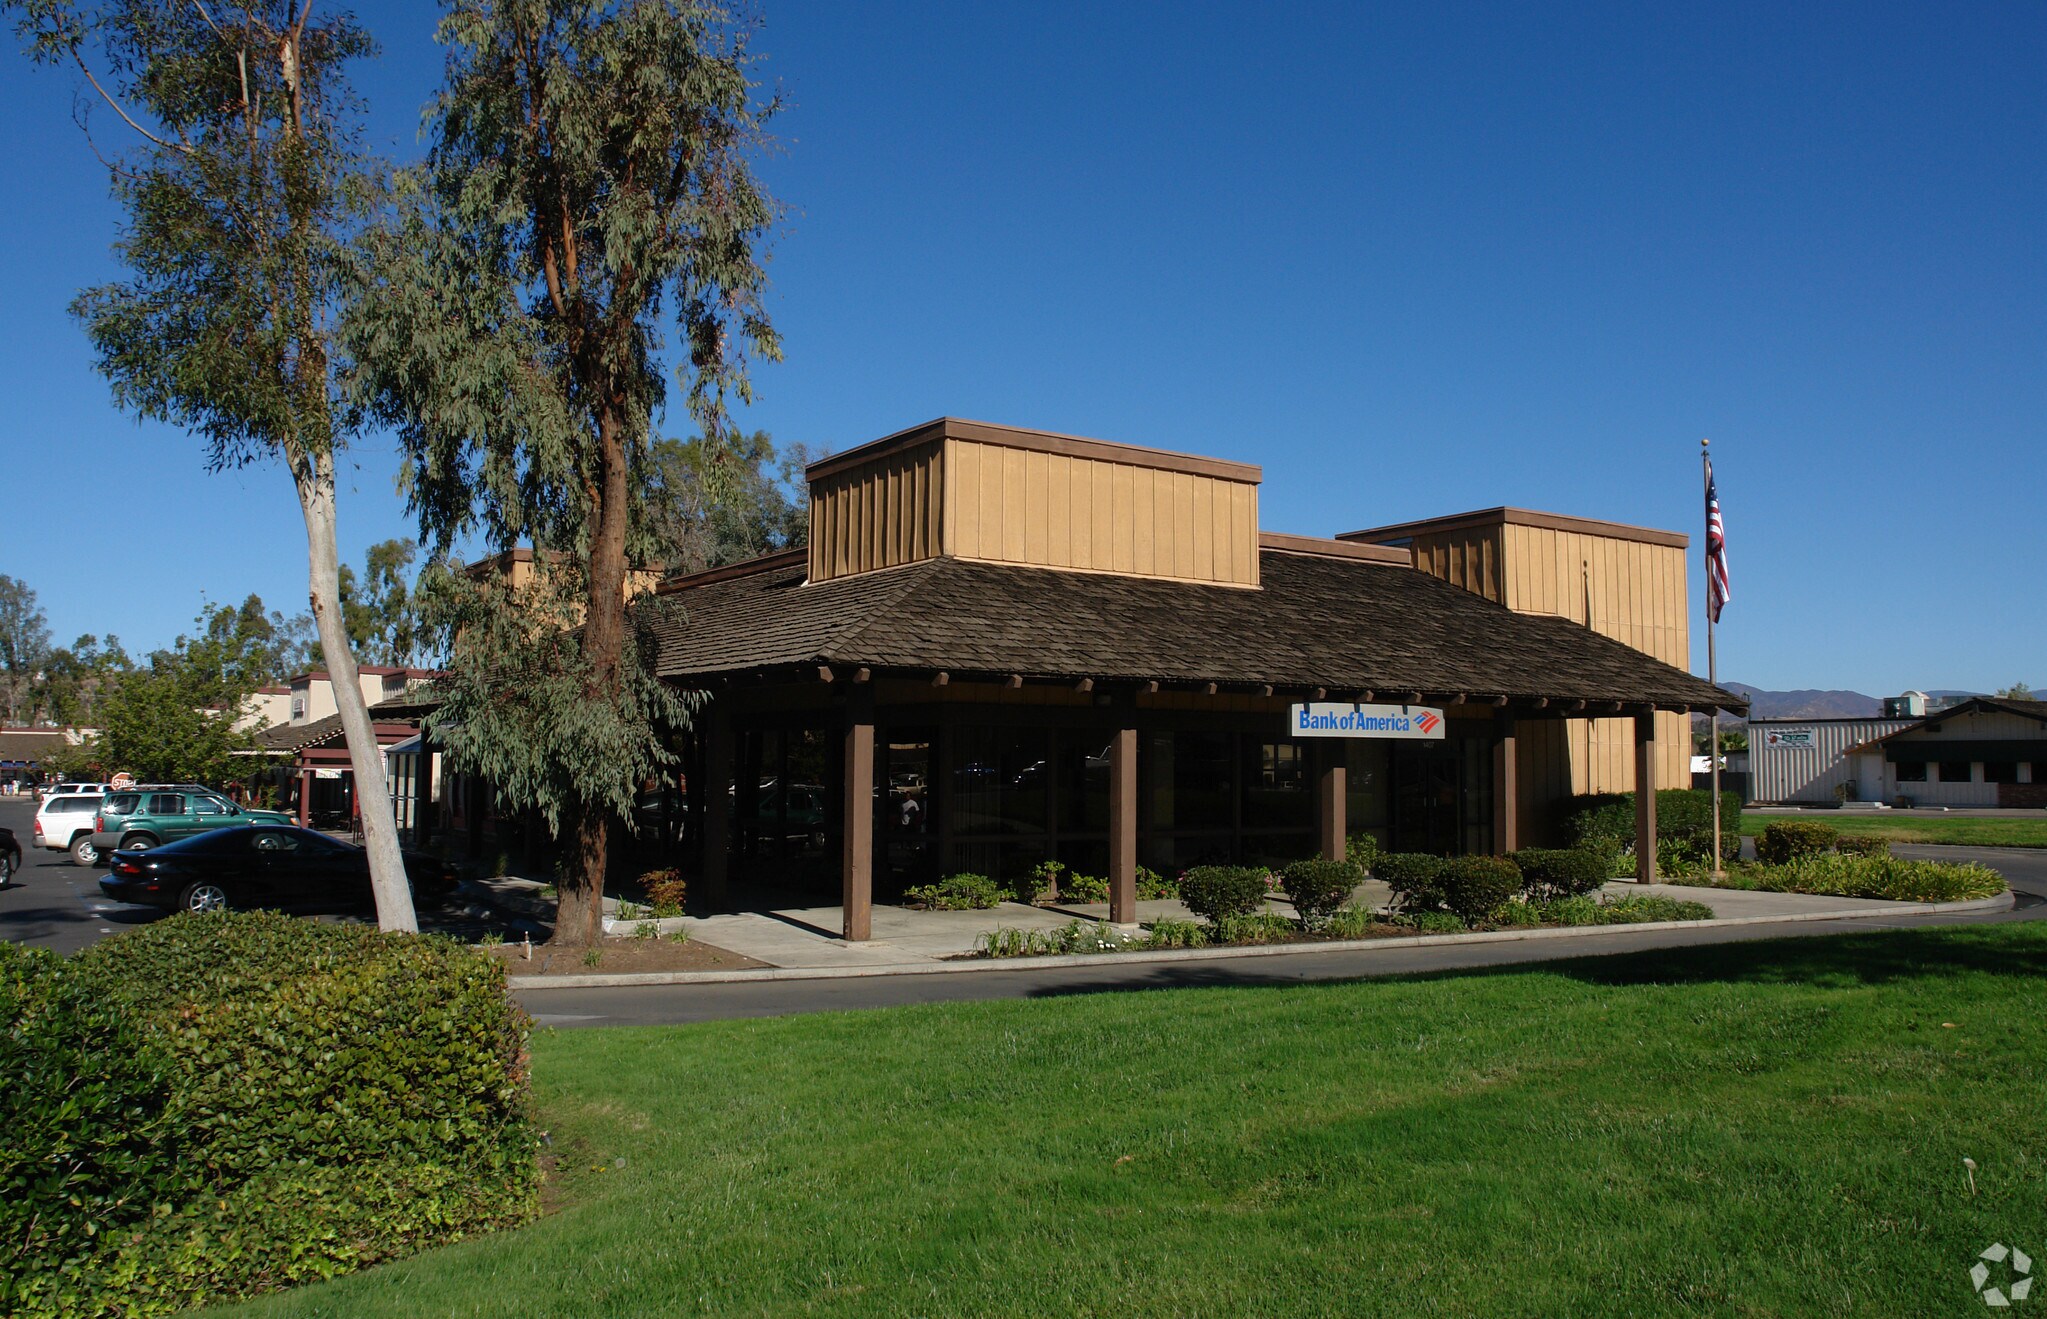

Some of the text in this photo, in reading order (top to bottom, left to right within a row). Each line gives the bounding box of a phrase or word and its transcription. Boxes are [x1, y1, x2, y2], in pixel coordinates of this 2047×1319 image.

[1299, 711, 1409, 731] Bank of America
[113, 778, 134, 787] STOP
